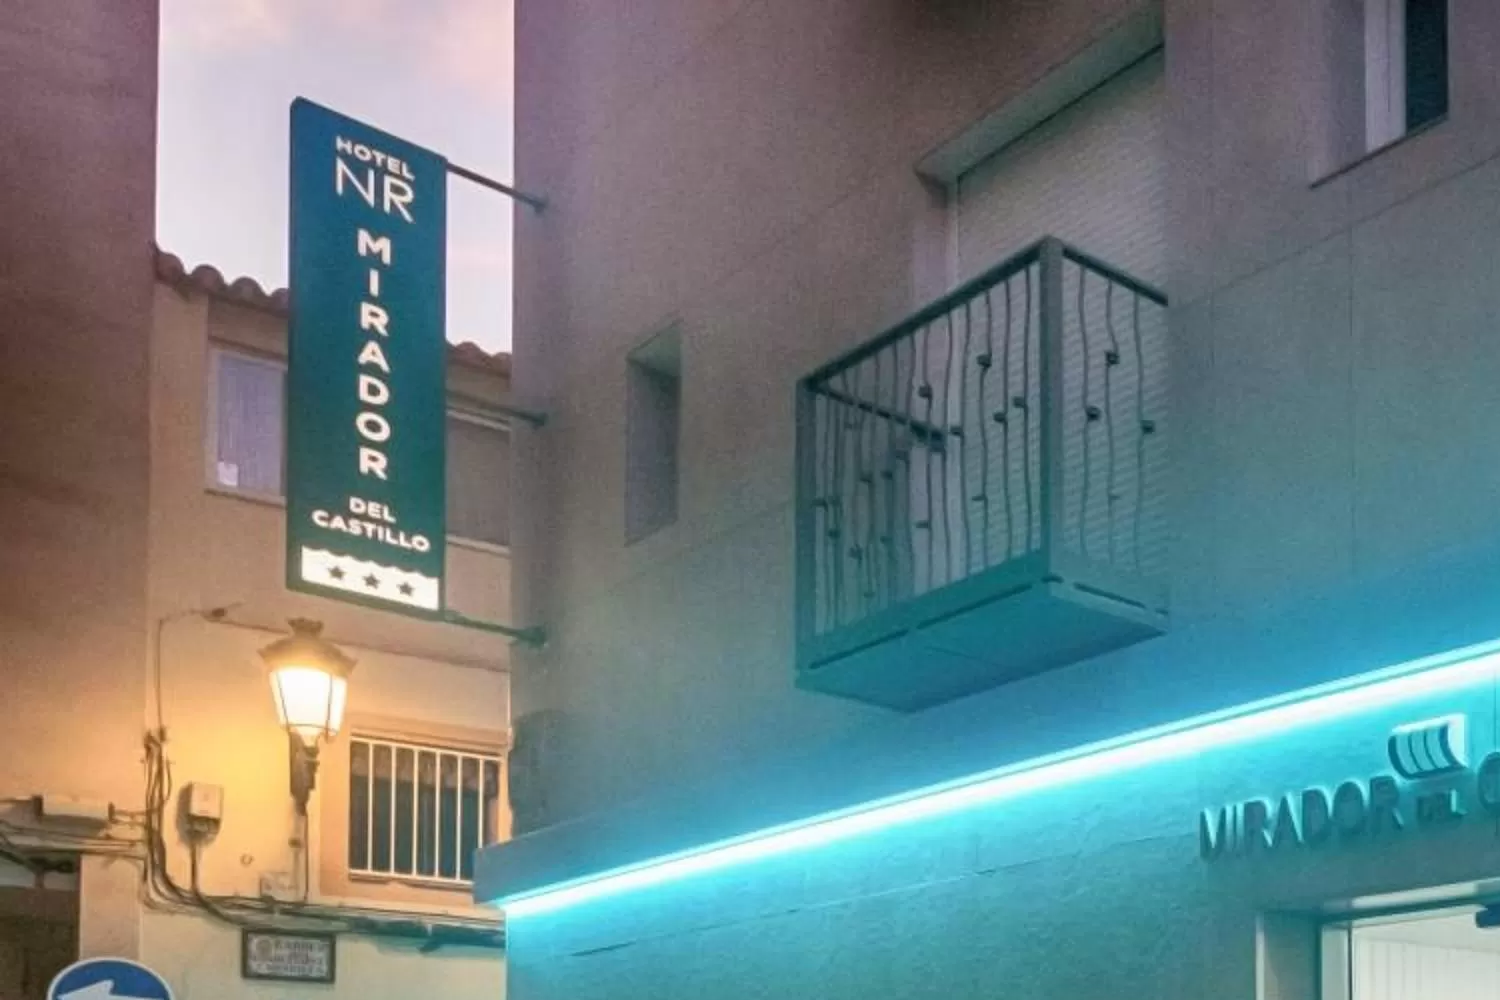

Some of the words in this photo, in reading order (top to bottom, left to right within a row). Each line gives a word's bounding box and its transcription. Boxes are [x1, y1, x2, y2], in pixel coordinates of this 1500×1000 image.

[335, 134, 416, 182] HOTEL
[335, 156, 415, 224] NR
[356, 227, 392, 481] MIRADOR
[311, 509, 431, 552] CASTILLO
[349, 496, 396, 524] DEL
[1199, 774, 1405, 862] MIRADOR
